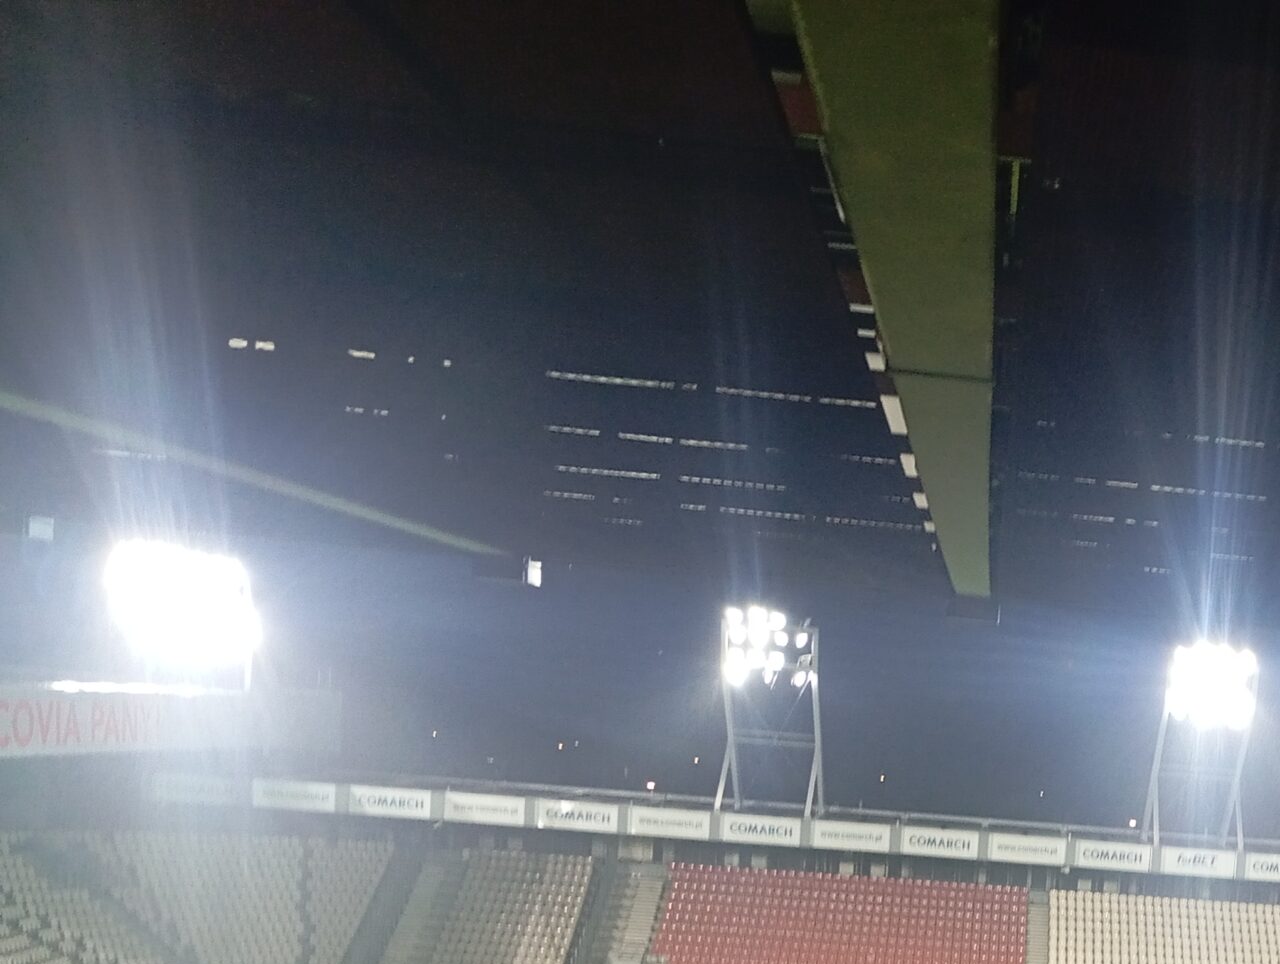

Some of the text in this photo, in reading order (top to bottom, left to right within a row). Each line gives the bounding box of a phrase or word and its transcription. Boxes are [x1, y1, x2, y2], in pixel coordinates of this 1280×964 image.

[358, 793, 424, 809] COMARCH
[545, 808, 611, 825] COMARCH
[729, 822, 793, 838] COMARCH
[908, 834, 970, 851] COMARCH
[1082, 848, 1143, 864] COMARCH
